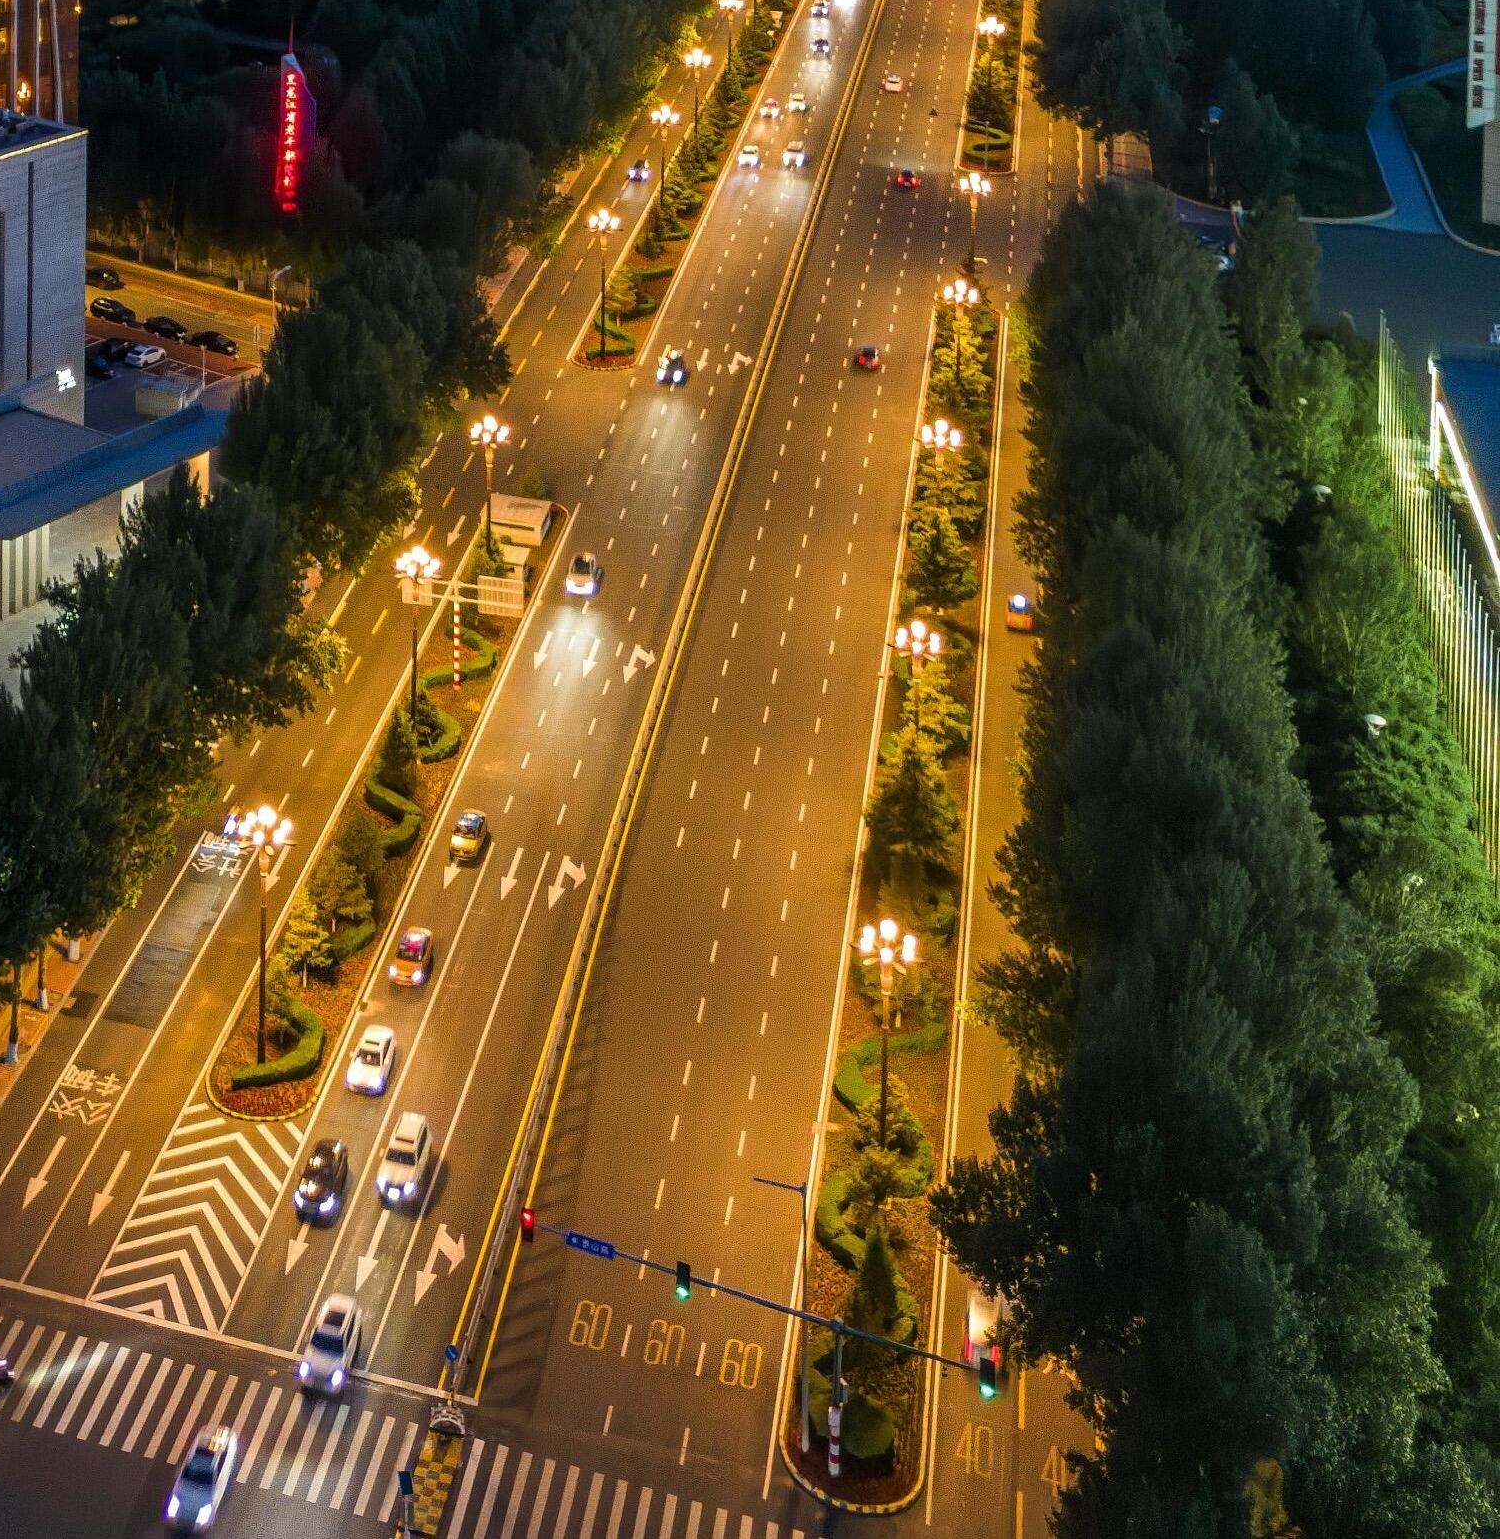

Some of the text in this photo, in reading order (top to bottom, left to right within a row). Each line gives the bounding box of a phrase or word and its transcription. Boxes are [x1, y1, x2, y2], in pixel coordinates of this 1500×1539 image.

[282, 73, 298, 212] 黑龙江省老干部
[568, 1300, 613, 1351] 60
[719, 1338, 764, 1390] 60
[955, 1421, 994, 1479] 40
